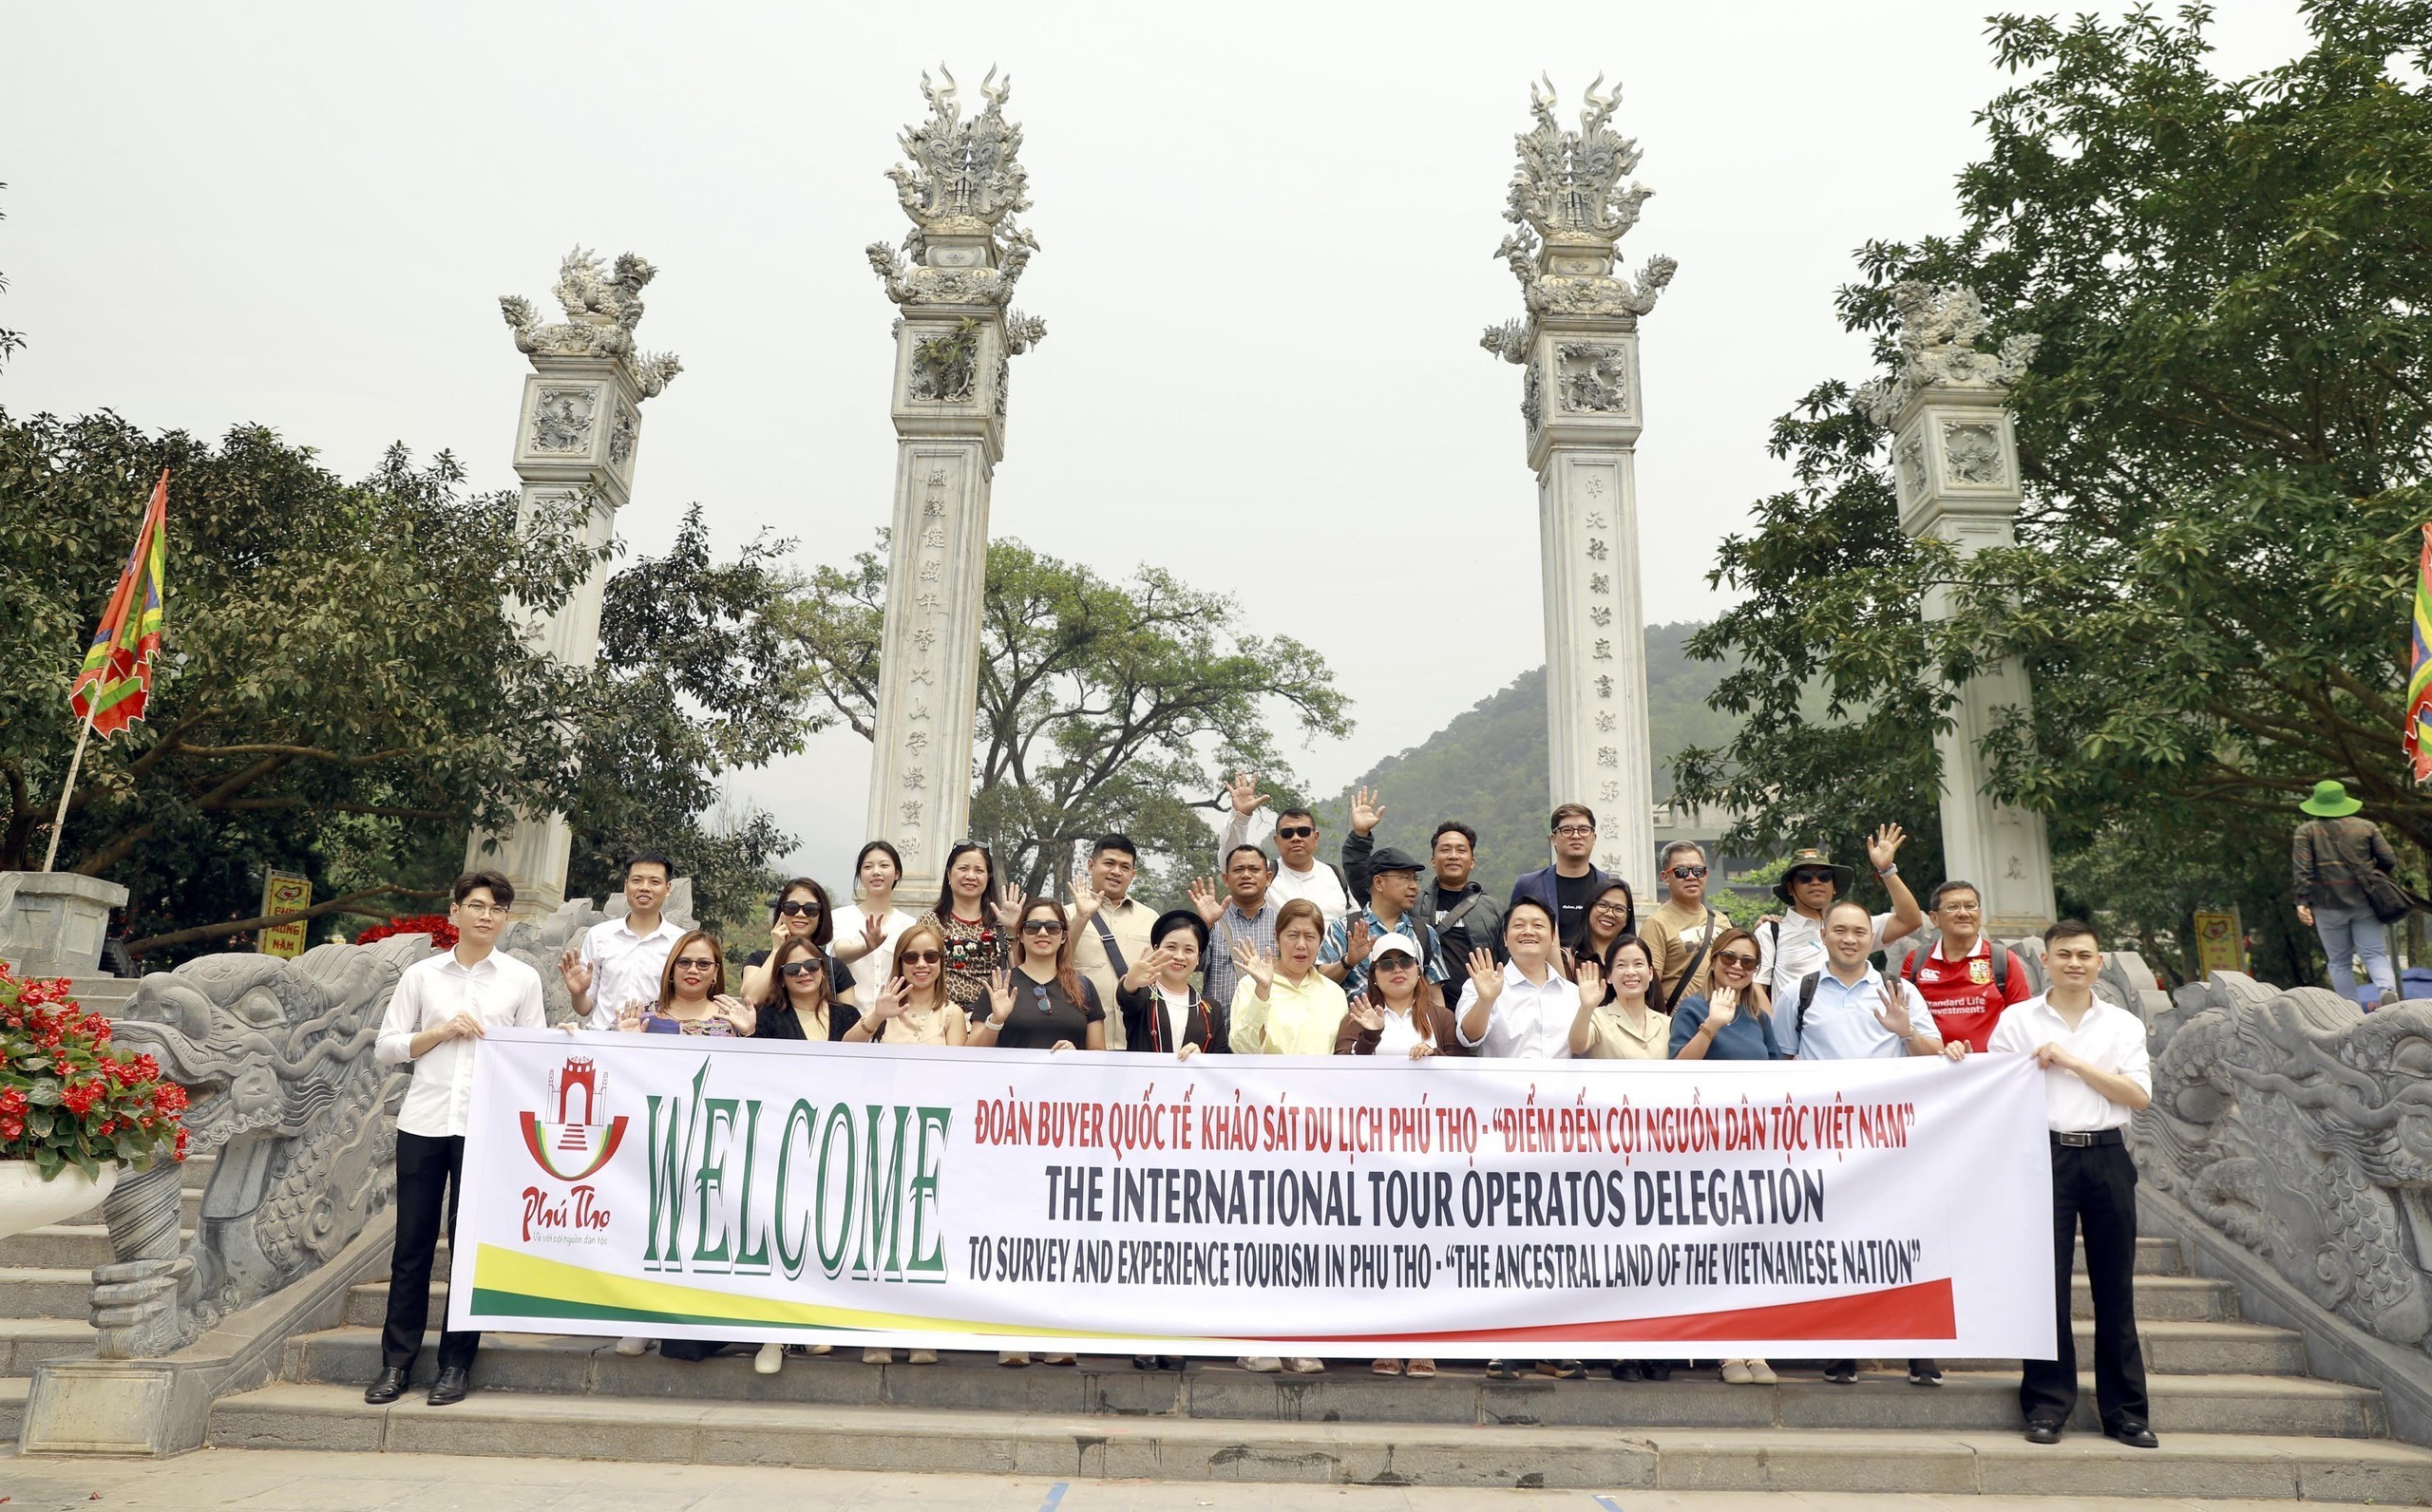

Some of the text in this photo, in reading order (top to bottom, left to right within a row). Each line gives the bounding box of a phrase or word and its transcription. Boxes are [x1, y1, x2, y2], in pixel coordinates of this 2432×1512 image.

[1927, 996, 1986, 1008] tandard Life
[975, 1086, 1033, 1145] ĐOÀN
[1037, 1102, 1104, 1147] BUYER
[1109, 1083, 1167, 1162] QUỐC
[1170, 1083, 1195, 1150] TẾ
[1202, 1088, 1259, 1152] KHẢO
[1264, 1092, 1300, 1153] SÁT
[1304, 1106, 1332, 1153] DU
[1339, 1106, 1383, 1165] LỊCH
[1389, 1092, 1431, 1154] PHÚ
[1435, 1106, 1477, 1167] THỌ
[1560, 1087, 1602, 1153] ĐẾN
[1606, 1093, 1642, 1166] CỘI
[1646, 1087, 1720, 1153] NGUỒN
[1725, 1093, 1766, 1151] DÂN
[1771, 1092, 1809, 1164] TỘC
[1813, 1091, 1854, 1162] VIỆT
[643, 1053, 954, 1284] WELCOME
[1045, 1165, 1825, 1228] THE INTERNATIONAL TOUR OPERATOS DELEGATION
[522, 1184, 611, 1242] Phú Thọ
[969, 1236, 992, 1282] TO
[996, 1236, 1071, 1282] SURVEY
[1073, 1238, 1113, 1284] AND
[1118, 1240, 1229, 1287] EXPERIENCE
[1234, 1241, 1320, 1289] TOURISM
[1325, 1244, 1344, 1288] IN
[1350, 1243, 1389, 1290] PHU
[1393, 1243, 1432, 1290] THO
[1494, 1243, 1601, 1290] ANCESTRAL
[1604, 1243, 1653, 1288] LAND
[1657, 1242, 1681, 1287] OF
[1684, 1242, 1718, 1285] THE
[1723, 1239, 1838, 1285] VIETNAMESE
